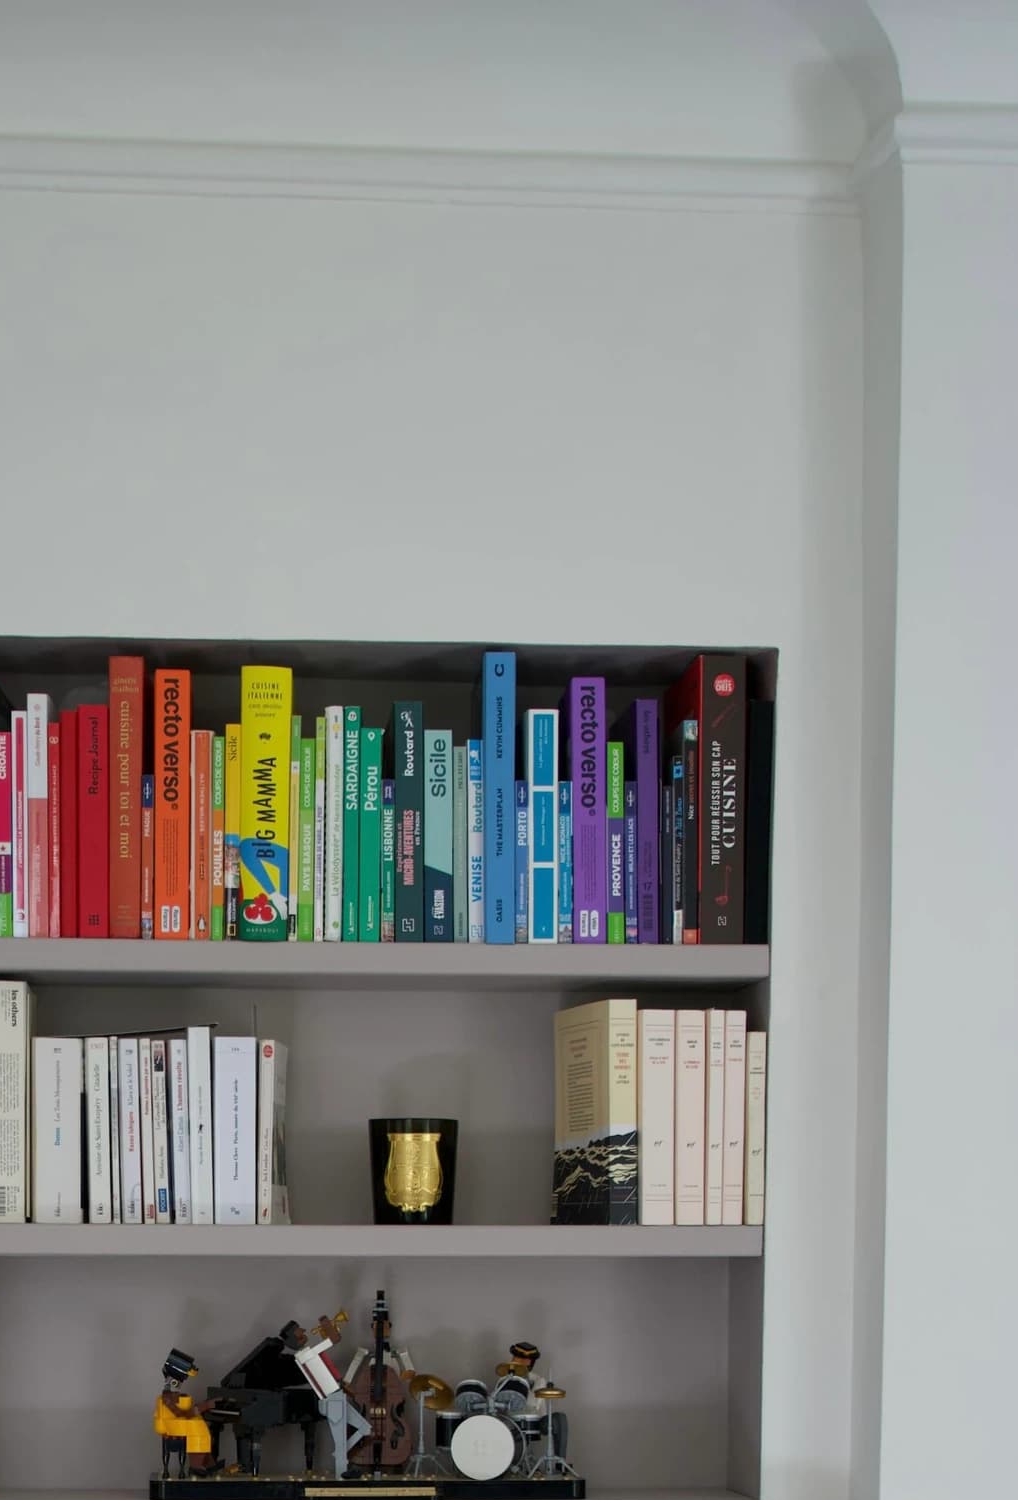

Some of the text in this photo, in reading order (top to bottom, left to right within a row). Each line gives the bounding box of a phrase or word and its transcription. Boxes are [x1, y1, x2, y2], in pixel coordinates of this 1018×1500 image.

[163, 678, 182, 738] recto
[247, 692, 283, 700] ITALIENNE
[251, 682, 279, 690] CUISINE
[120, 700, 134, 749] cuisine
[580, 685, 599, 743] recto
[87, 716, 103, 795] Recipe Journal
[117, 753, 130, 787] pour
[228, 735, 238, 761] Sicile
[346, 730, 358, 810] SARDAIGNE
[404, 730, 414, 777] Routard
[430, 739, 446, 797] Sicile
[120, 791, 134, 809] toi
[364, 765, 378, 811] Pérou
[612, 776, 620, 787] DE
[612, 787, 620, 813] COUPS
[710, 740, 721, 865] TOUT POUR RÉUSSIR SON CAP
[722, 758, 736, 848] CUISINE
[119, 814, 130, 827] et
[251, 757, 277, 858] BIG MAMMA
[472, 782, 483, 833] Routard
[517, 811, 527, 846] PORTO
[119, 832, 134, 859] moi
[213, 830, 223, 886] POUILLES
[302, 823, 311, 891] PAYS BASQUE
[383, 809, 393, 861] LISBONNE
[403, 809, 414, 886] MICRO-AVENTURES
[471, 856, 482, 903] VENISE
[612, 834, 621, 897] PROVENCE
[331, 887, 339, 897] La
